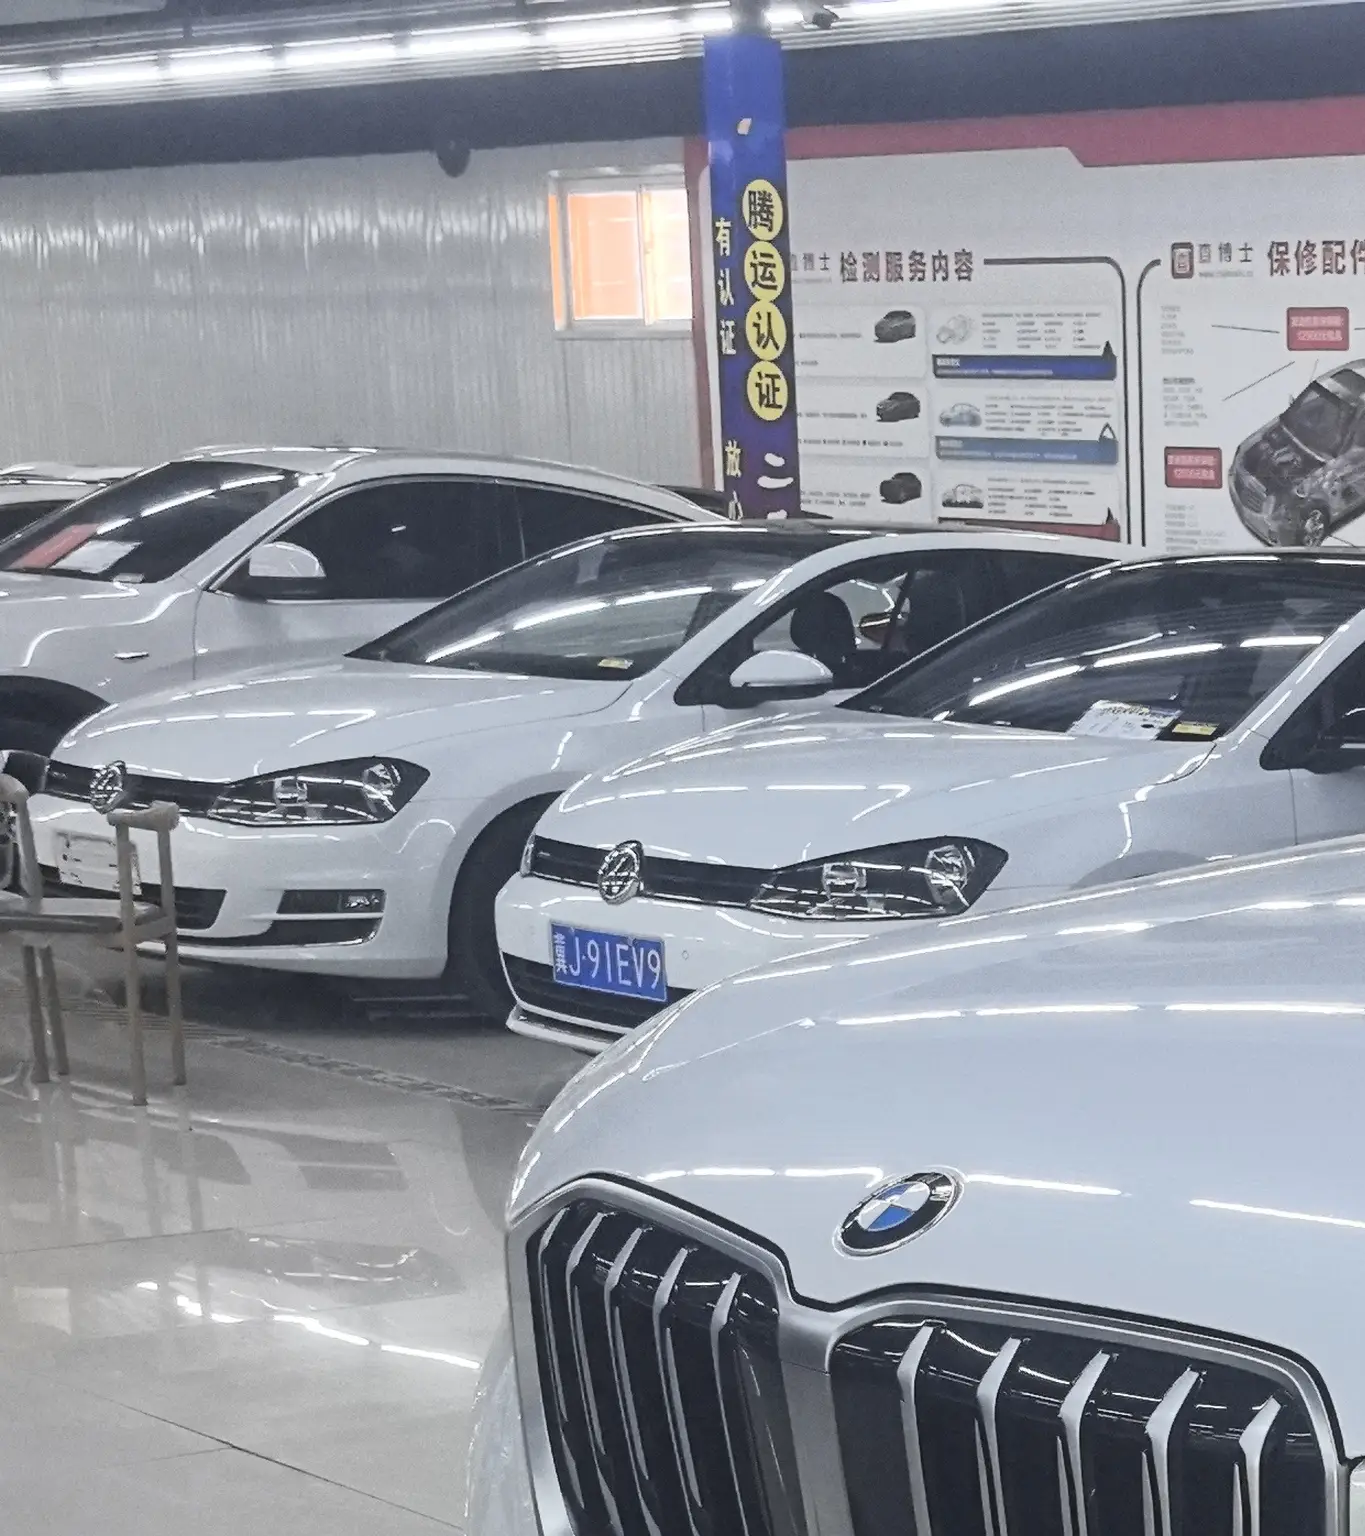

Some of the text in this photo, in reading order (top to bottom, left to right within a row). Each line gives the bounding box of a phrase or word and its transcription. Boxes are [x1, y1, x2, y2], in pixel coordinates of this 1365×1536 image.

[747, 190, 784, 410] 腾运认证
[840, 249, 974, 283] 检测服务内容
